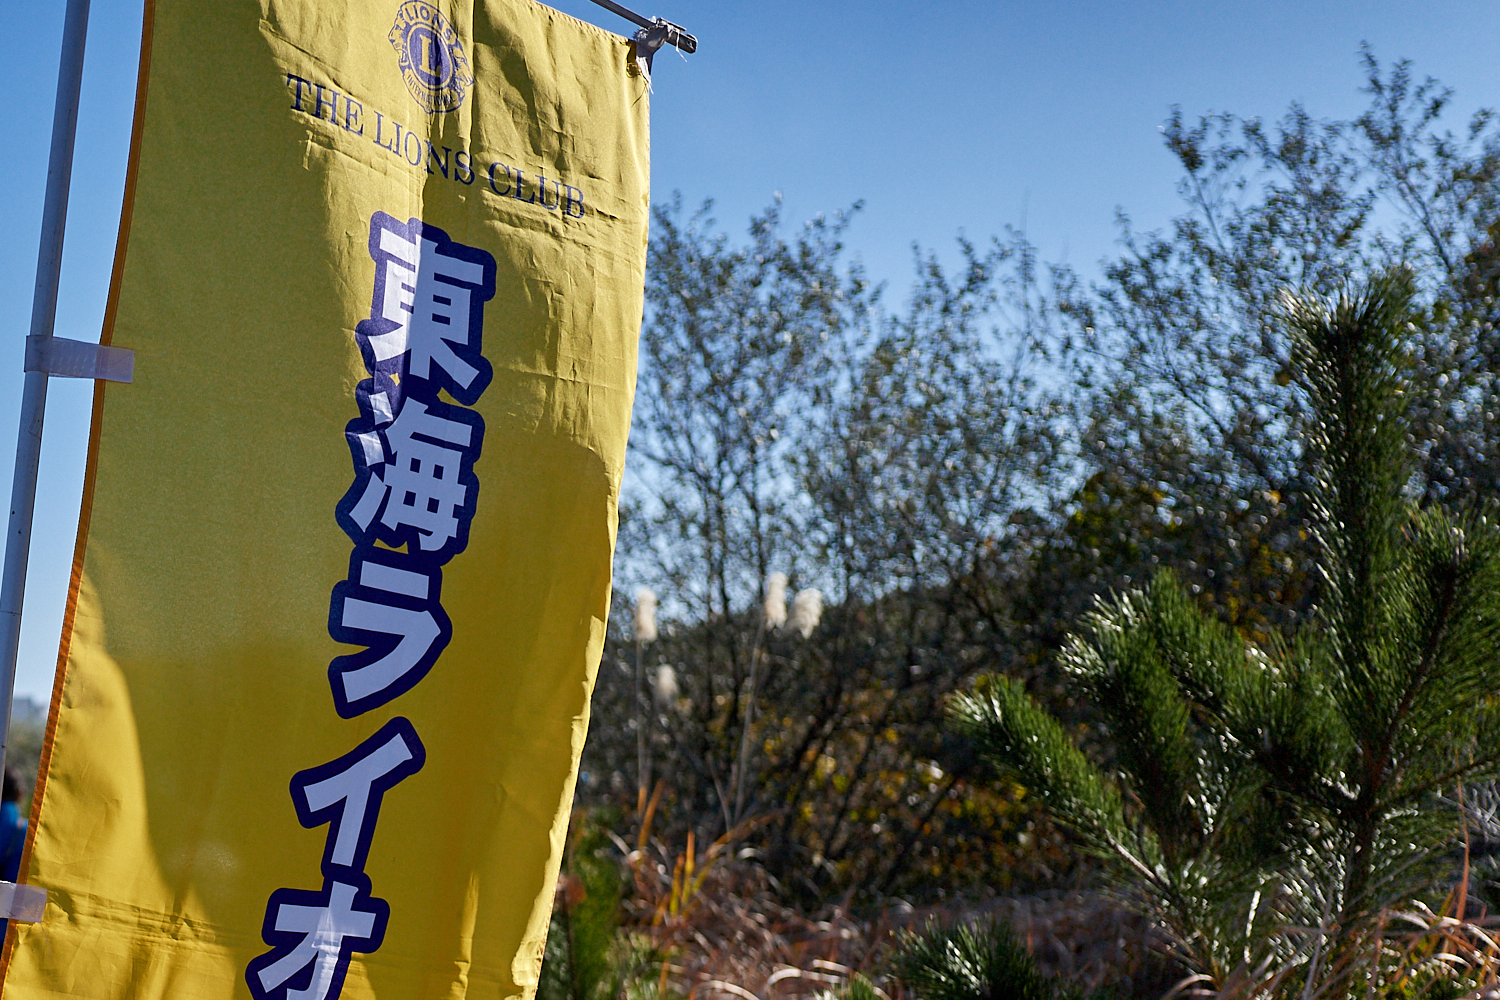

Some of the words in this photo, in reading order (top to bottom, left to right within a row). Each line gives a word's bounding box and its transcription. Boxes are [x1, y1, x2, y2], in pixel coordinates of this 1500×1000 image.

[404, 4, 453, 41] LIONS
[286, 73, 364, 137] THE
[373, 110, 474, 186] LIONS
[487, 161, 586, 220] CLUB
